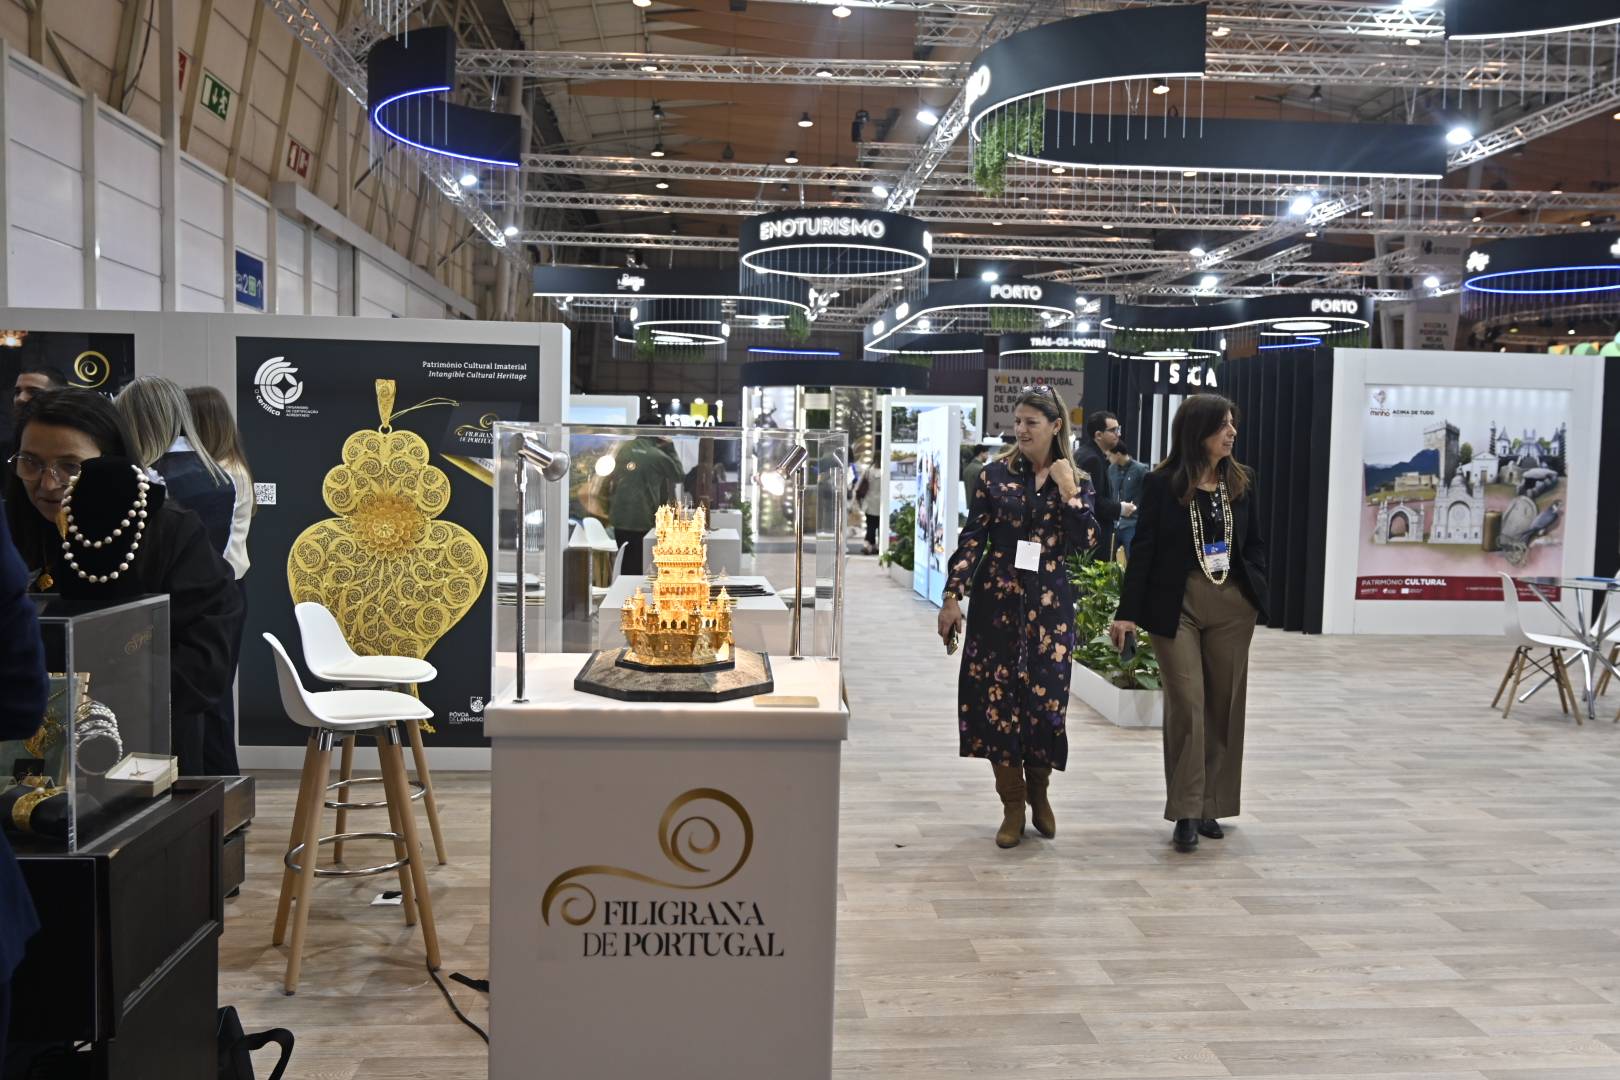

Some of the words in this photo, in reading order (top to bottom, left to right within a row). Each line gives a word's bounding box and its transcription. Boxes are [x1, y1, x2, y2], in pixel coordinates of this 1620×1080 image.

[759, 217, 885, 240] ENOTURISMO
[990, 284, 1042, 301] PORTO
[1311, 298, 1358, 314] PORTO
[422, 360, 463, 369] Património
[463, 362, 493, 370] Cultural
[494, 363, 527, 371] Imaterial
[428, 370, 465, 379] Intangible
[466, 371, 495, 379] Cultural
[496, 372, 527, 381] Heritage
[1031, 376, 1073, 386] PORTUGAL
[1404, 578, 1447, 586] CULTURAL
[604, 901, 765, 926] FILIGRANA
[583, 932, 618, 957] DE
[623, 932, 785, 957] PORTUGAL
